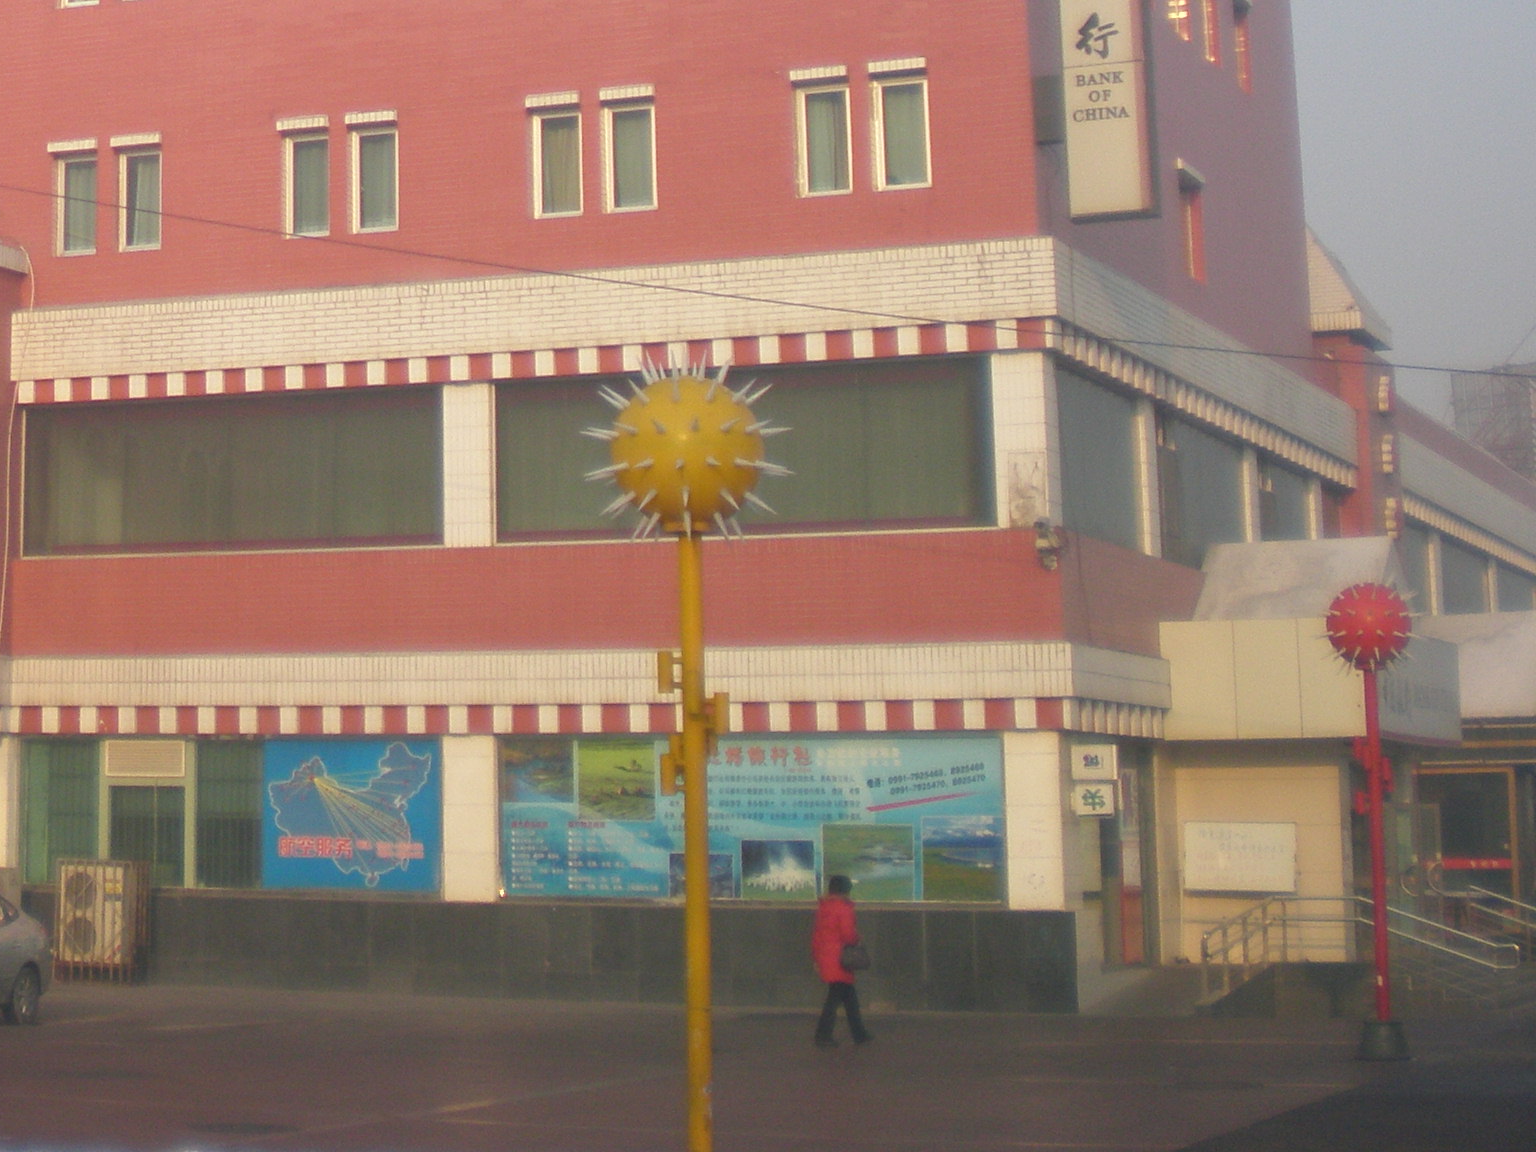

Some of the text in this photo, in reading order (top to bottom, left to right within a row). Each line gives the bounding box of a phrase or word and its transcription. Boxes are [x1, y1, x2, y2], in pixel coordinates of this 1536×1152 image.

[1076, 71, 1124, 87] BANK
[1088, 90, 1112, 103] OF
[1073, 106, 1130, 123] CHINA
